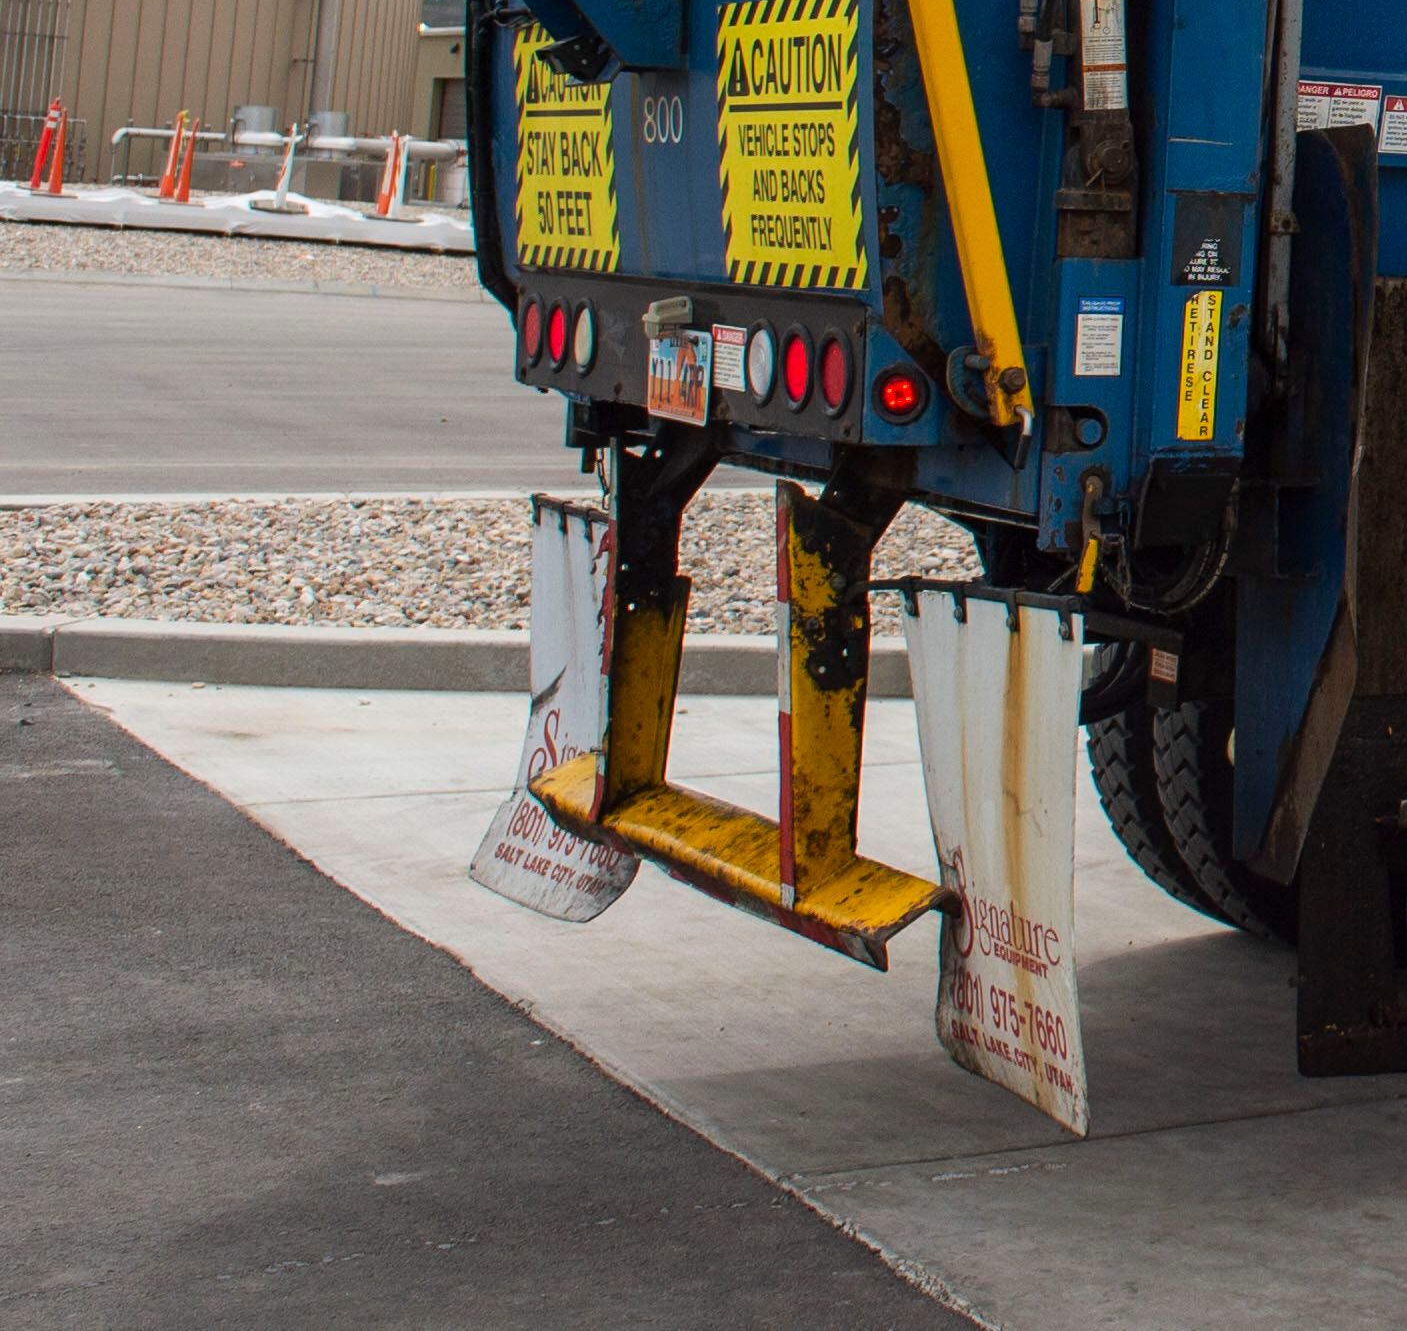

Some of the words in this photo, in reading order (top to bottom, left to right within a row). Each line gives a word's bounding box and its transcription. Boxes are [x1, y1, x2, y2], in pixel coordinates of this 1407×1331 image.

[751, 33, 842, 95] CAUTION
[1298, 85, 1329, 95] ANGER
[1343, 88, 1378, 98] PELIGRO
[644, 96, 683, 143] 800
[738, 123, 789, 156] VEHICLE
[793, 122, 835, 157] STOPS
[527, 131, 556, 176] STAY
[561, 131, 602, 177] BACK
[753, 169, 777, 202] AND
[782, 170, 825, 204] BACKS
[537, 191, 553, 235] 50
[556, 190, 592, 236] FEET
[751, 214, 832, 250] FREQUENTLY
[1203, 295, 1217, 360] STAND
[1200, 370, 1212, 437] CLEAR
[494, 842, 524, 865] SALT
[523, 853, 551, 877] LAKE
[551, 864, 575, 890] CITY,
[952, 845, 1061, 966] Signature
[993, 942, 1049, 979] EQUIPMENT
[953, 957, 984, 1024] (801)
[990, 984, 1067, 1060] 975-7660
[952, 1019, 980, 1047] SALT
[983, 1031, 1012, 1062] LAKE
[1045, 1062, 1074, 1095] UTAH
